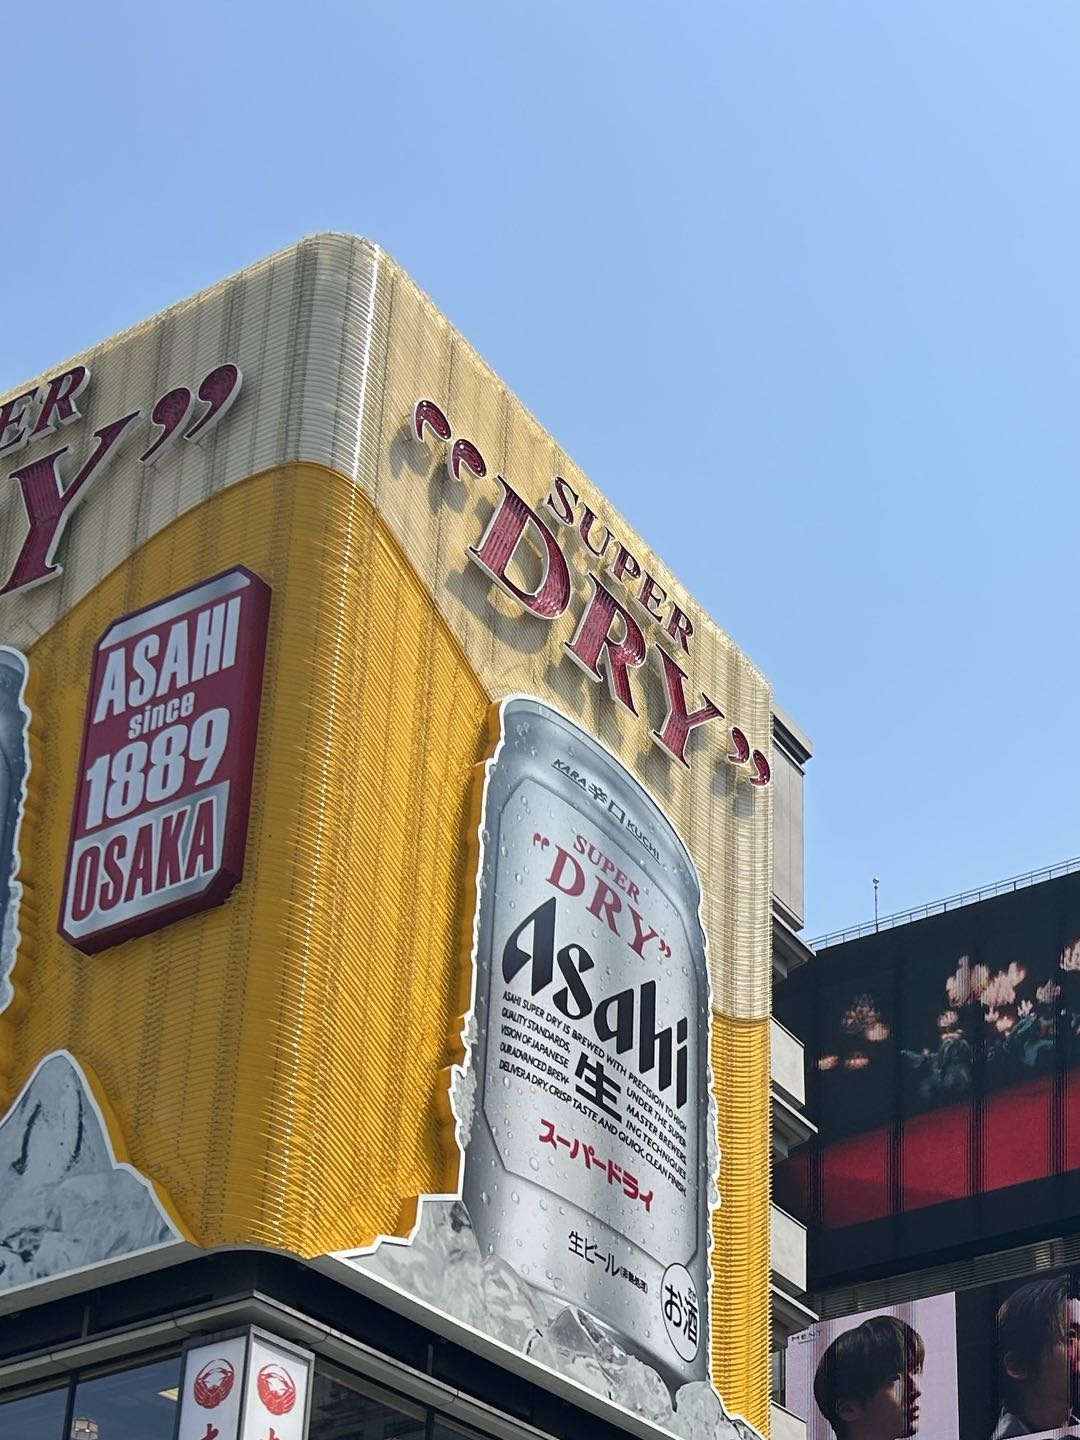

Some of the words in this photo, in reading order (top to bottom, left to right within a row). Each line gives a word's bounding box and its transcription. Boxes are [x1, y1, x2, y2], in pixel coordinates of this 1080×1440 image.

[545, 477, 694, 656] SUPER
[93, 596, 241, 725] ASAHI
[128, 691, 195, 739] since
[85, 707, 230, 830] 1889
[554, 759, 587, 787] KARA
[627, 820, 660, 860] KUCHI
[71, 798, 215, 922] OSAKA
[573, 834, 640, 900] SUPER
[502, 897, 688, 1109] Asahi
[503, 991, 522, 1007] ASAHI
[522, 999, 545, 1019] SUPER
[546, 1013, 562, 1029] DRY
[563, 1024, 571, 1035] IS
[572, 1029, 605, 1059] BREWED
[607, 1053, 627, 1077] WITH
[629, 1072, 664, 1110] PRECISION
[502, 1007, 528, 1027] QUALITY
[627, 1086, 654, 1116] UNDER
[654, 1109, 668, 1130] THE
[512, 1047, 547, 1072] ADVANCED
[626, 1120, 642, 1138] ING
[643, 1132, 687, 1180] TECHNIQUES
[531, 1038, 569, 1069] JAPANESE
[626, 1104, 658, 1137] MASTER
[575, 1051, 622, 1123] 生
[539, 1119, 654, 1212] スーパードライ
[549, 1085, 572, 1103] CRISP
[573, 1098, 598, 1122] TASTE
[598, 1117, 618, 1136] AND
[646, 1154, 668, 1177] CLEAN
[568, 1231, 620, 1277] 生ビール
[664, 1284, 699, 1347] お酒
